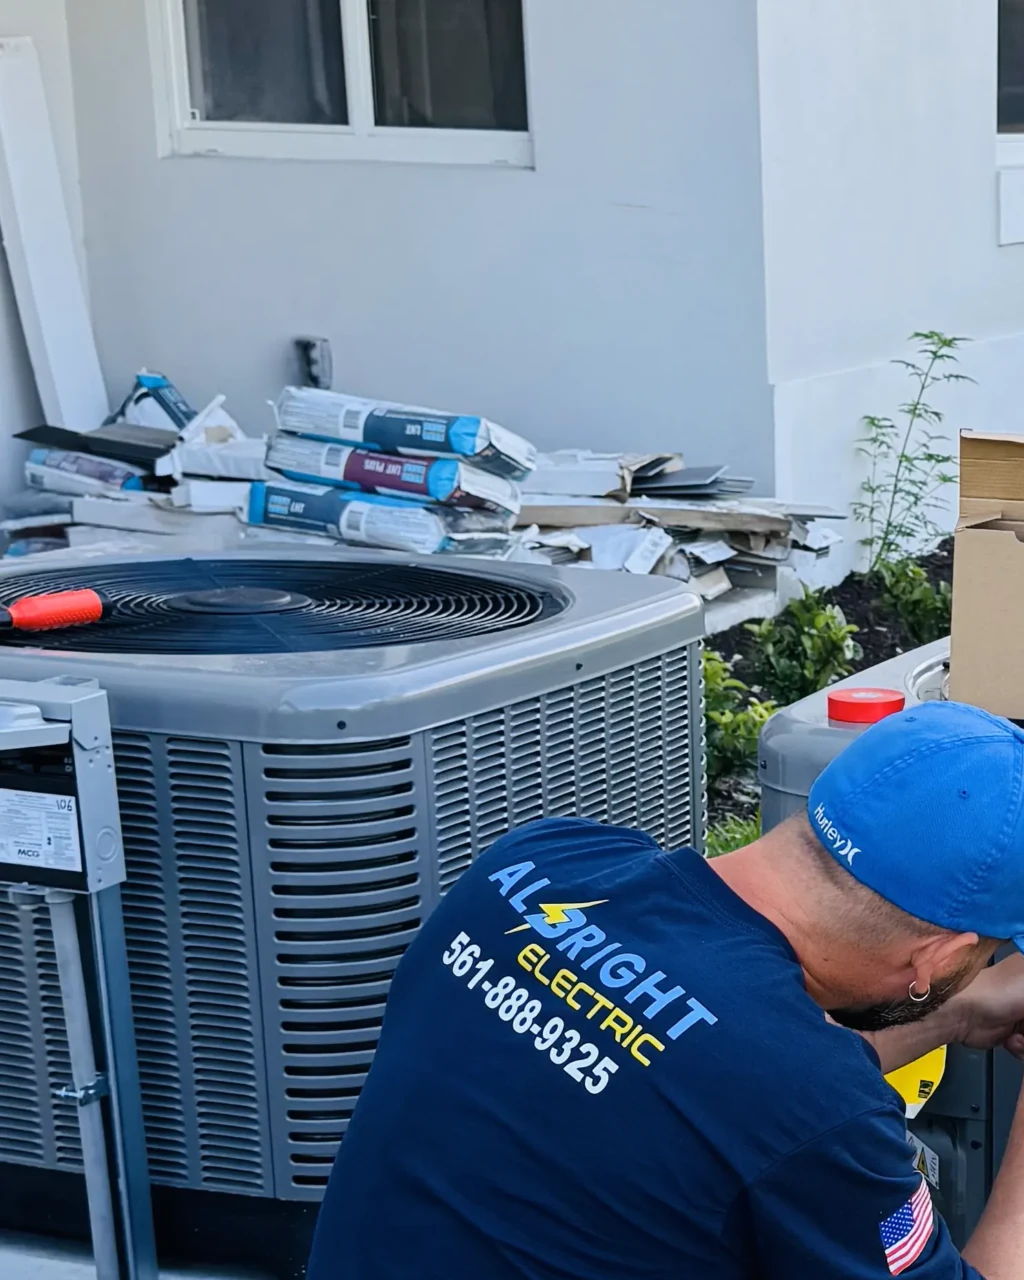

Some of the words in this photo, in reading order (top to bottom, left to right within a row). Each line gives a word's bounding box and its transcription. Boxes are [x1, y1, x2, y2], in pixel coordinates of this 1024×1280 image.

[56, 799, 73, 812] 106
[814, 802, 846, 848] Hurley
[488, 860, 719, 1041] ALBRIGHT
[517, 943, 666, 1067] ELECTRIC
[442, 931, 700, 1095] 561-888-9325
